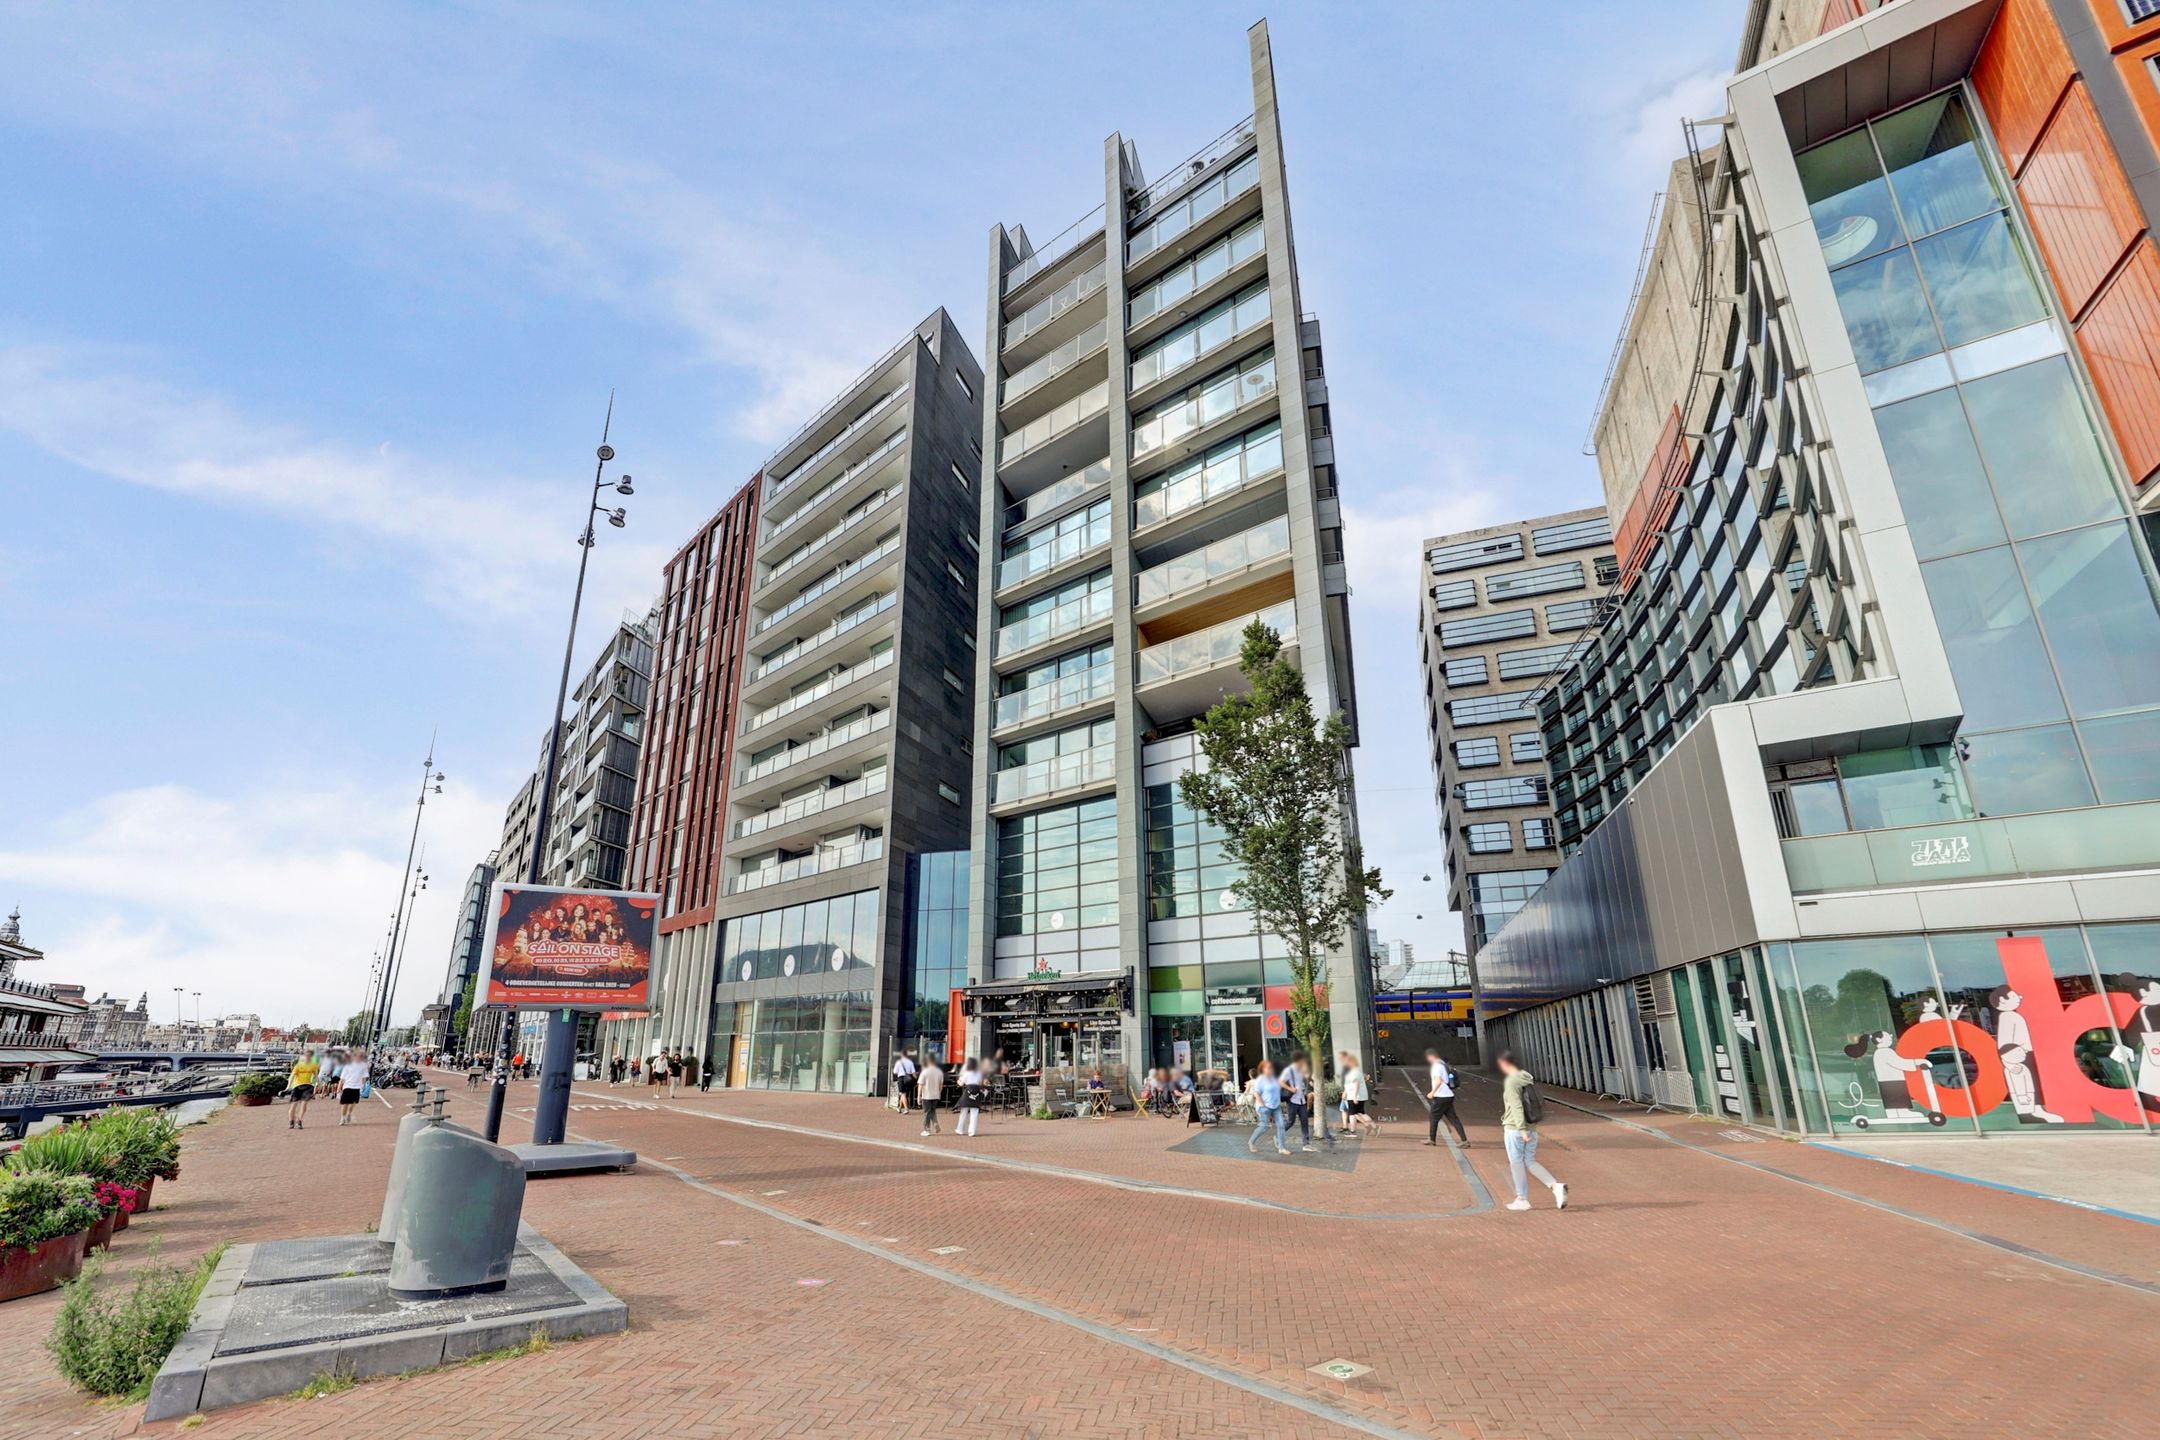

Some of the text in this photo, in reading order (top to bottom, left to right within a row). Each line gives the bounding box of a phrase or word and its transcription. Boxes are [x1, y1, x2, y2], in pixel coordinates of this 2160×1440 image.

[1912, 848, 1971, 862] GAJA
[558, 943, 580, 954] ON
[581, 944, 618, 957] STAGE
[1211, 997, 1257, 1005] coffeecompany
